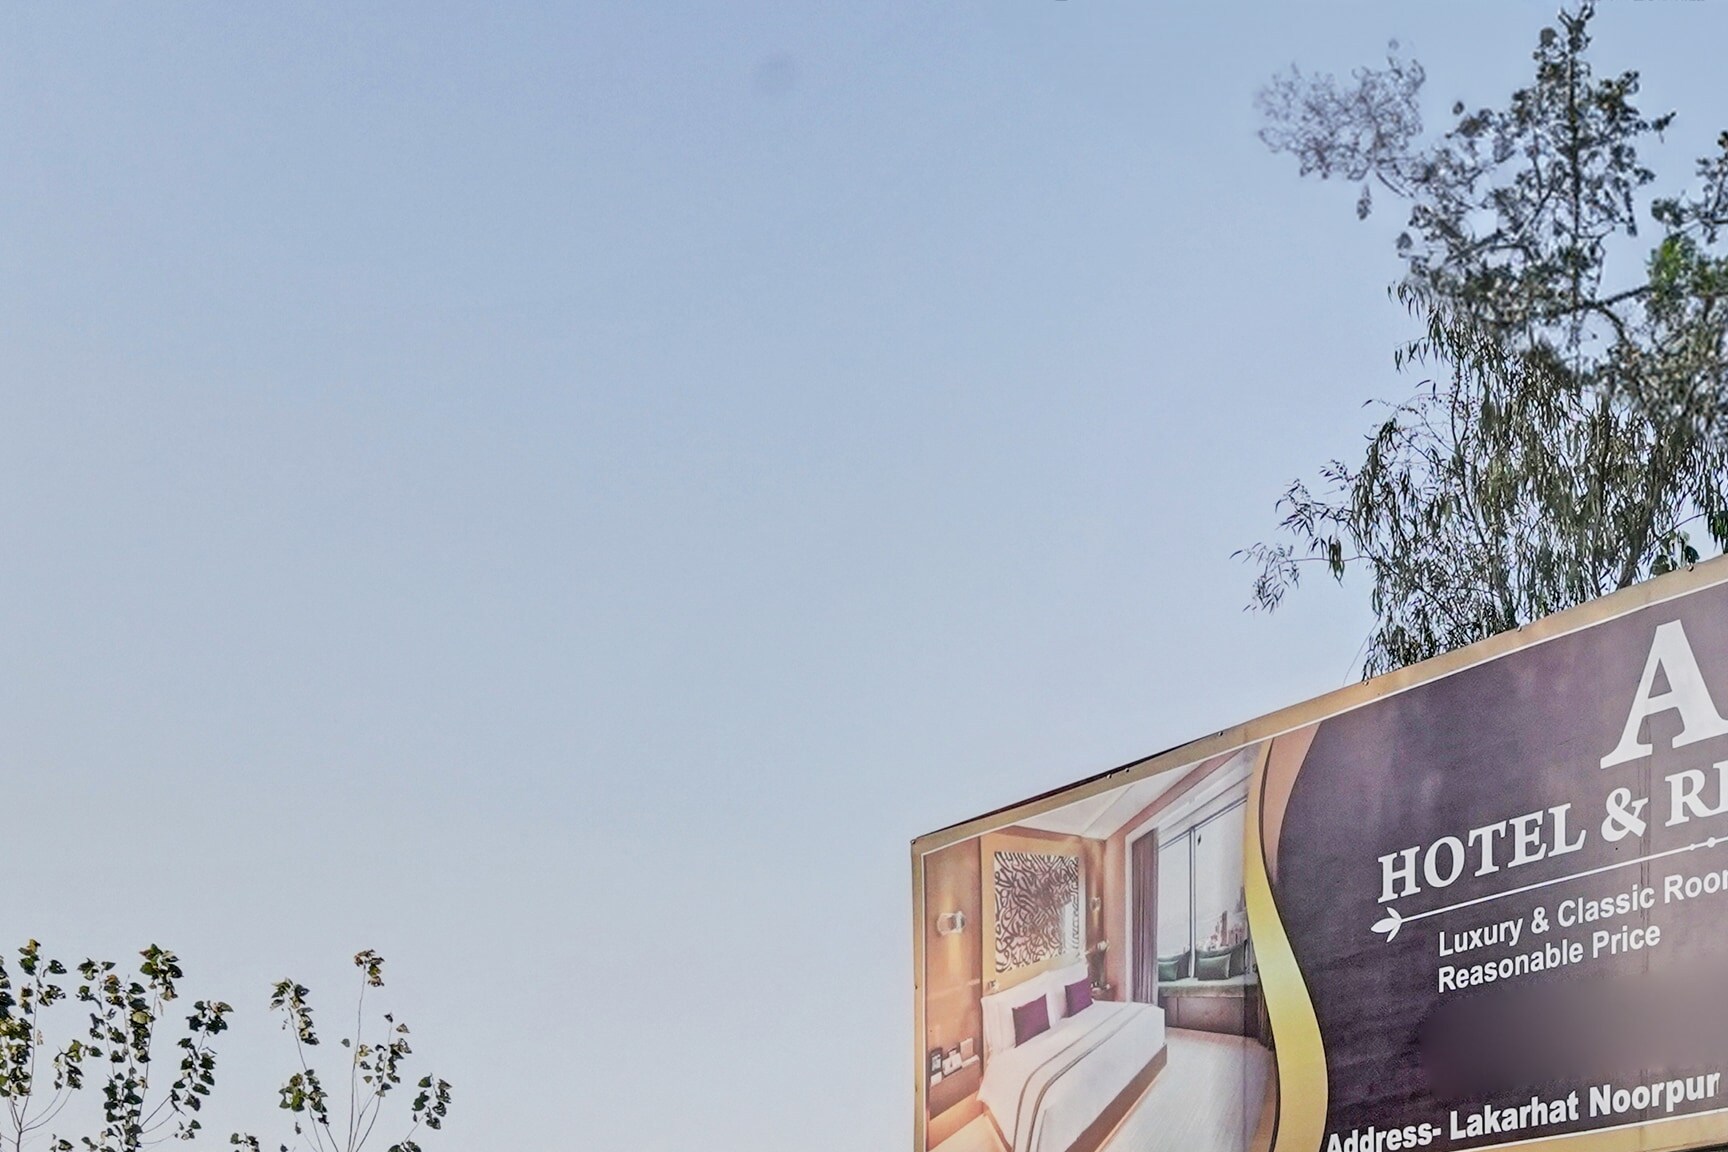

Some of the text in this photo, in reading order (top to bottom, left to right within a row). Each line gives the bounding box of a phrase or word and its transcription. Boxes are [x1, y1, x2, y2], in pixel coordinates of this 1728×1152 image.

[1377, 801, 1587, 904] HOTEL
[1601, 787, 1649, 842] &
[1438, 917, 1524, 957] Luxury
[1531, 906, 1550, 934] &
[1557, 884, 1655, 928] Classic
[1438, 923, 1661, 994] Reasonable Price
[1449, 1090, 1579, 1141] Lakarhat
[1589, 1071, 1721, 1117] Noorpur
